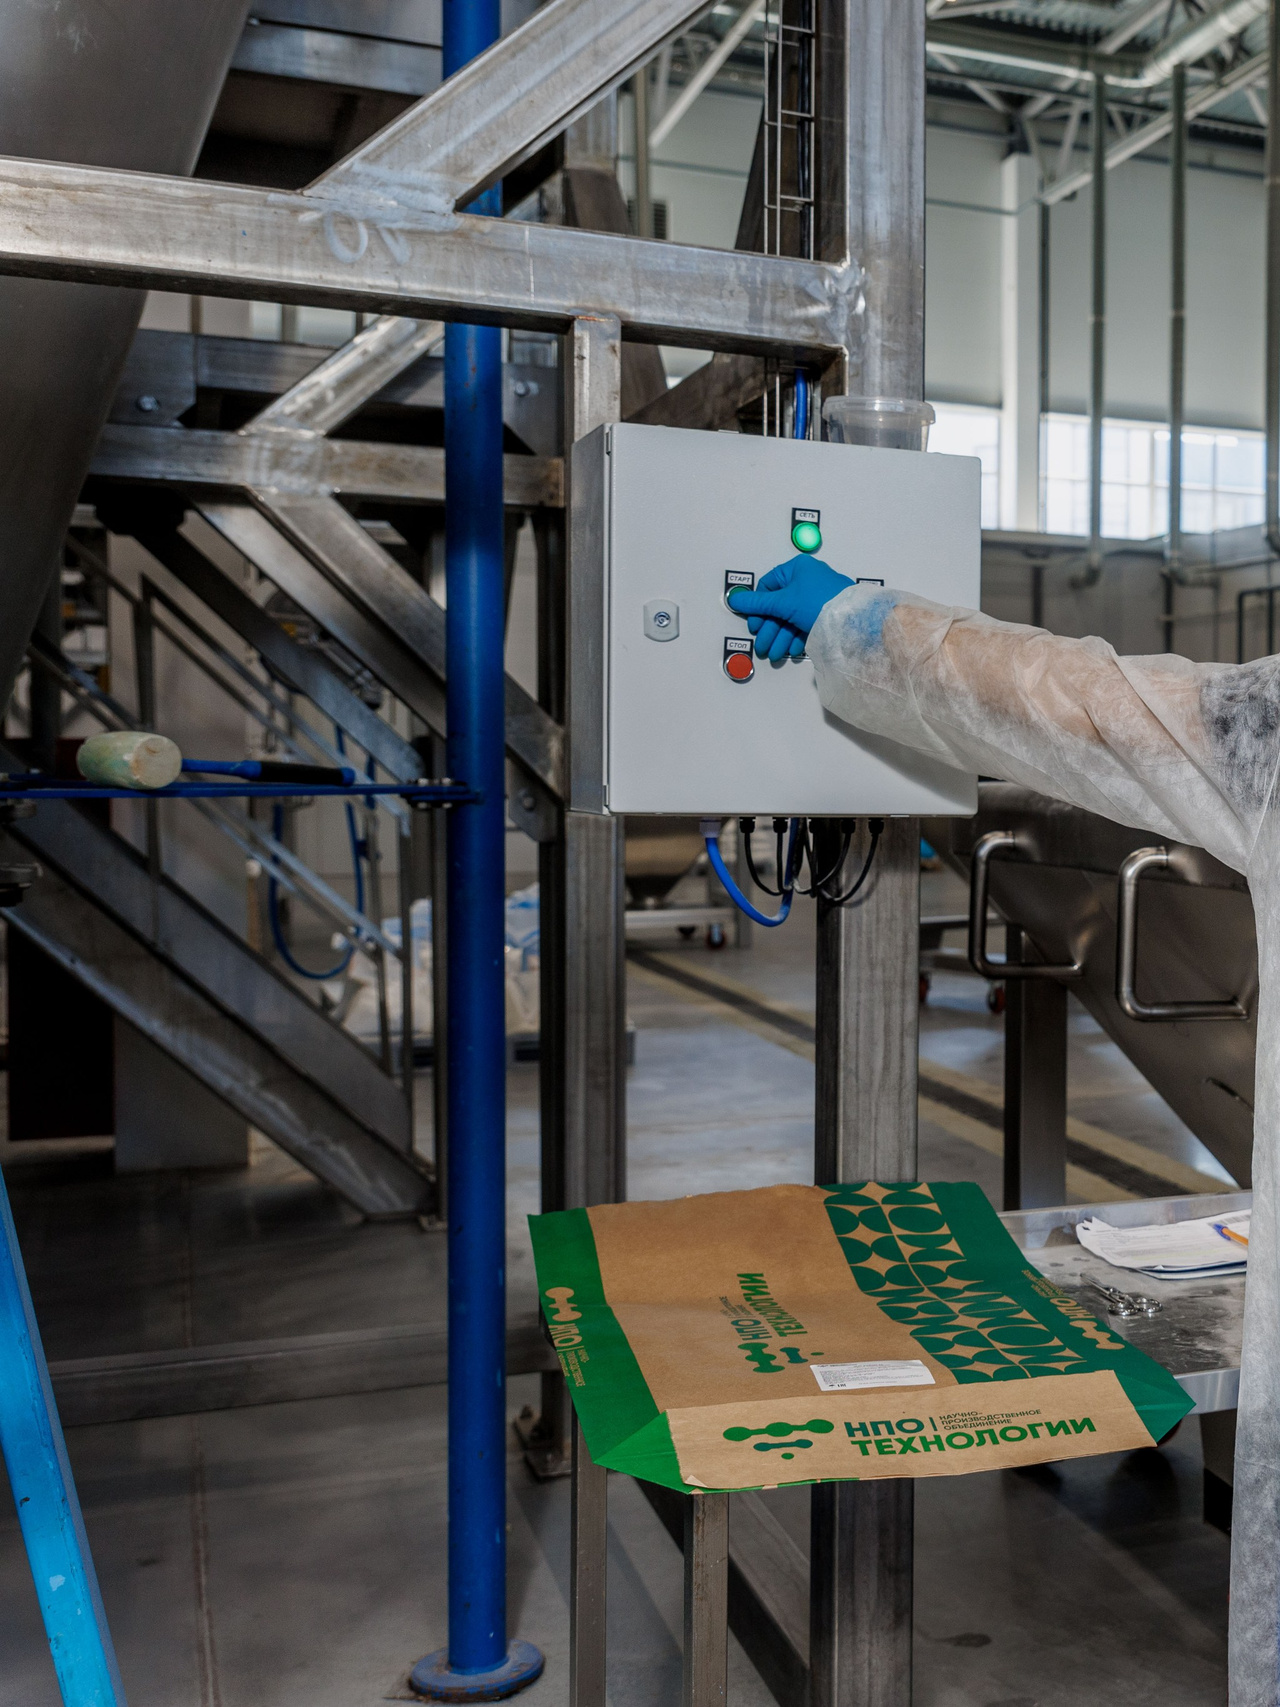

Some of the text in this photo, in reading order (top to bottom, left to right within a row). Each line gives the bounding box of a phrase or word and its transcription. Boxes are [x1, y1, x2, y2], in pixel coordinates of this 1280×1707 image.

[729, 575, 751, 583] СТАРТ
[736, 1273, 808, 1337] ТЕХНОЛОГИИ
[1049, 1297, 1097, 1320] НПО
[730, 1318, 773, 1341] НПО
[939, 1411, 983, 1421] НАУЧНО-
[941, 1408, 1042, 1425] ПРОИЗВОДСТВЕННОЕ
[943, 1419, 1013, 1431] ОБЪЕДИНЕНИЕ
[843, 1418, 925, 1437] НПО
[850, 1417, 1097, 1456] ТЕХНОЛОГИИ
